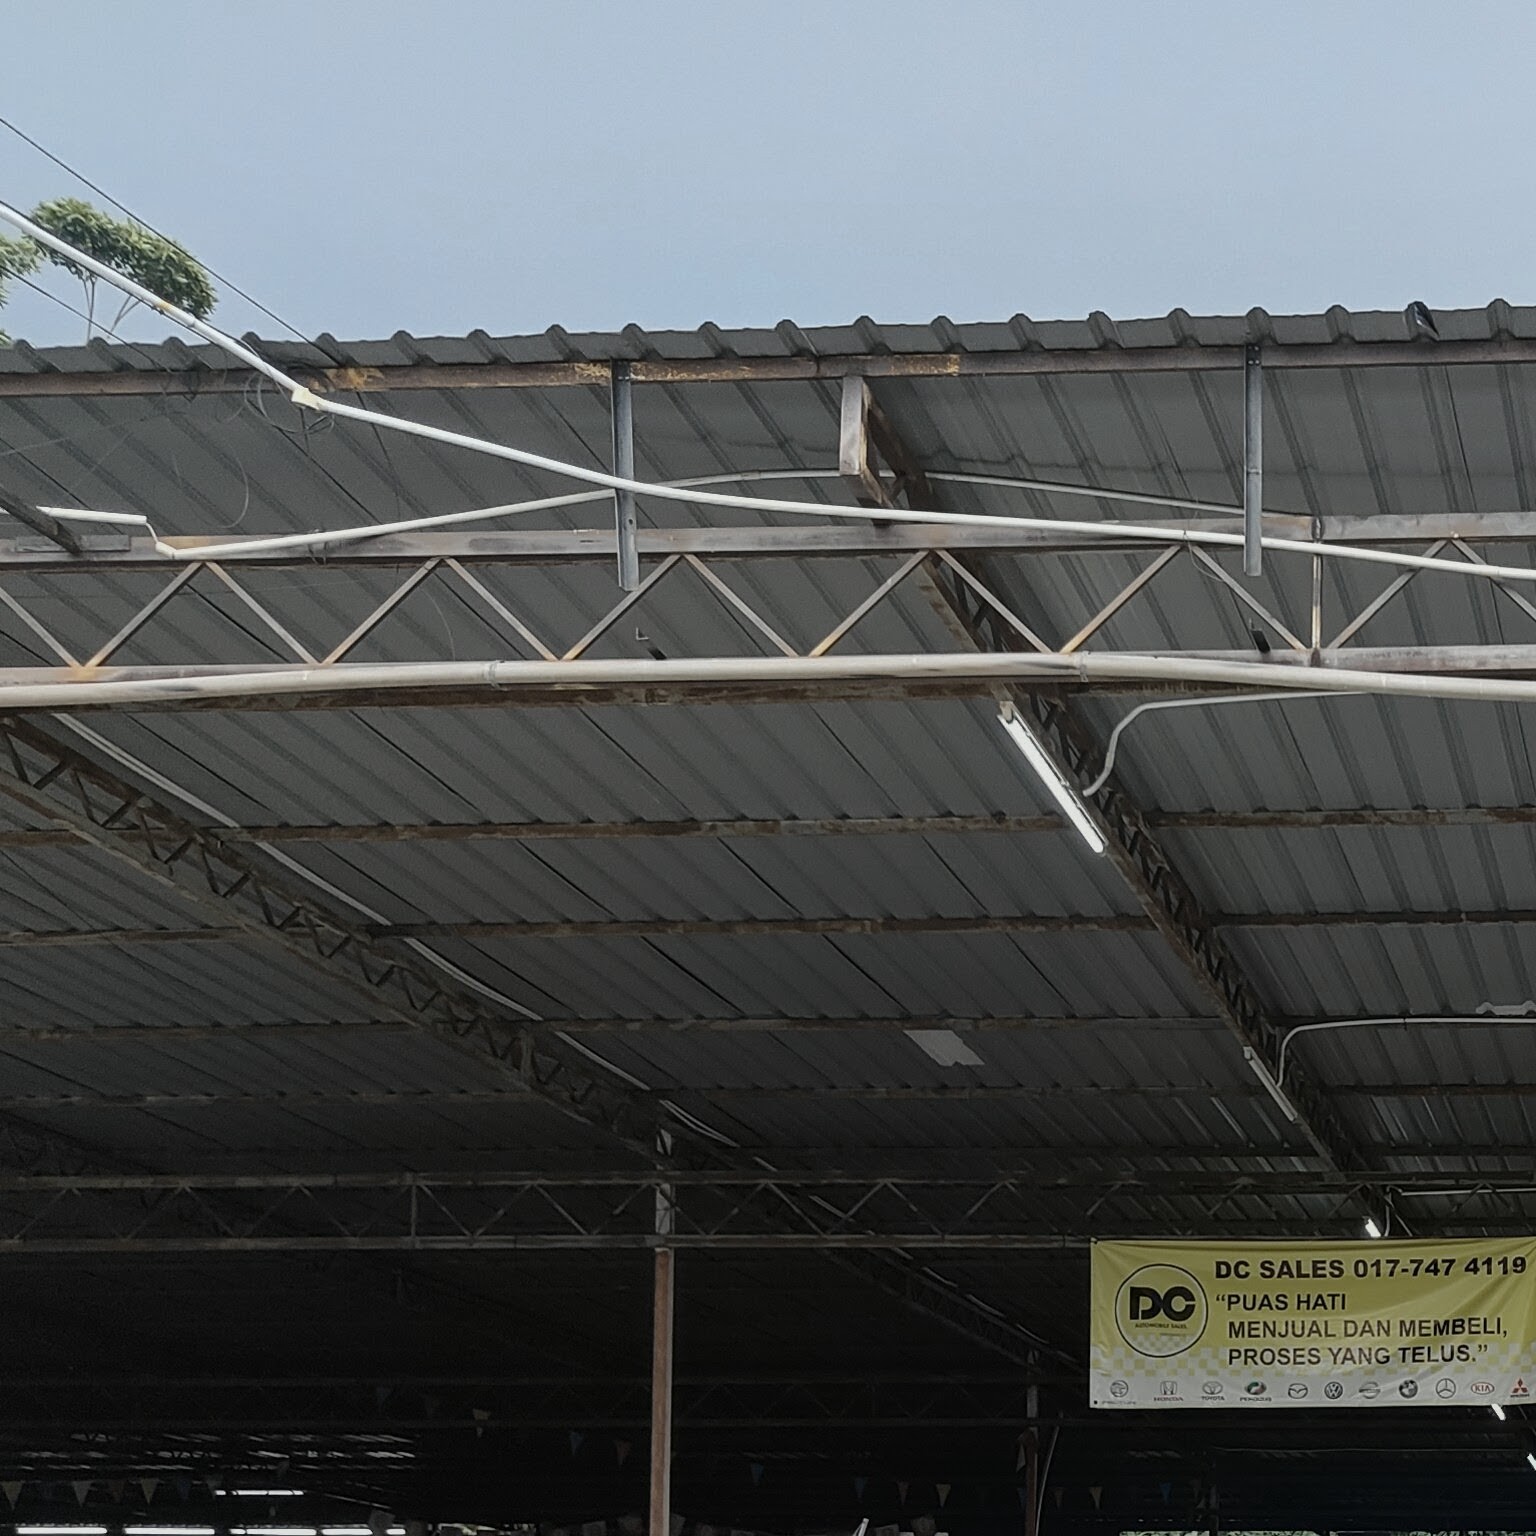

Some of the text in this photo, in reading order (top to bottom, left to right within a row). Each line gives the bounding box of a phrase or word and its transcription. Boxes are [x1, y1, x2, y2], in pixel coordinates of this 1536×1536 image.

[1215, 1256, 1527, 1279] DC SALES 017-747 4119
[1129, 1286, 1196, 1322] DC
[1296, 1293, 1346, 1311] HATI
[1228, 1317, 1508, 1338] MENJUAL DAN MEMBELI,
[1228, 1348, 1321, 1366] PROSES
[1328, 1347, 1390, 1365] YANG
[1473, 1382, 1494, 1394] KIA
